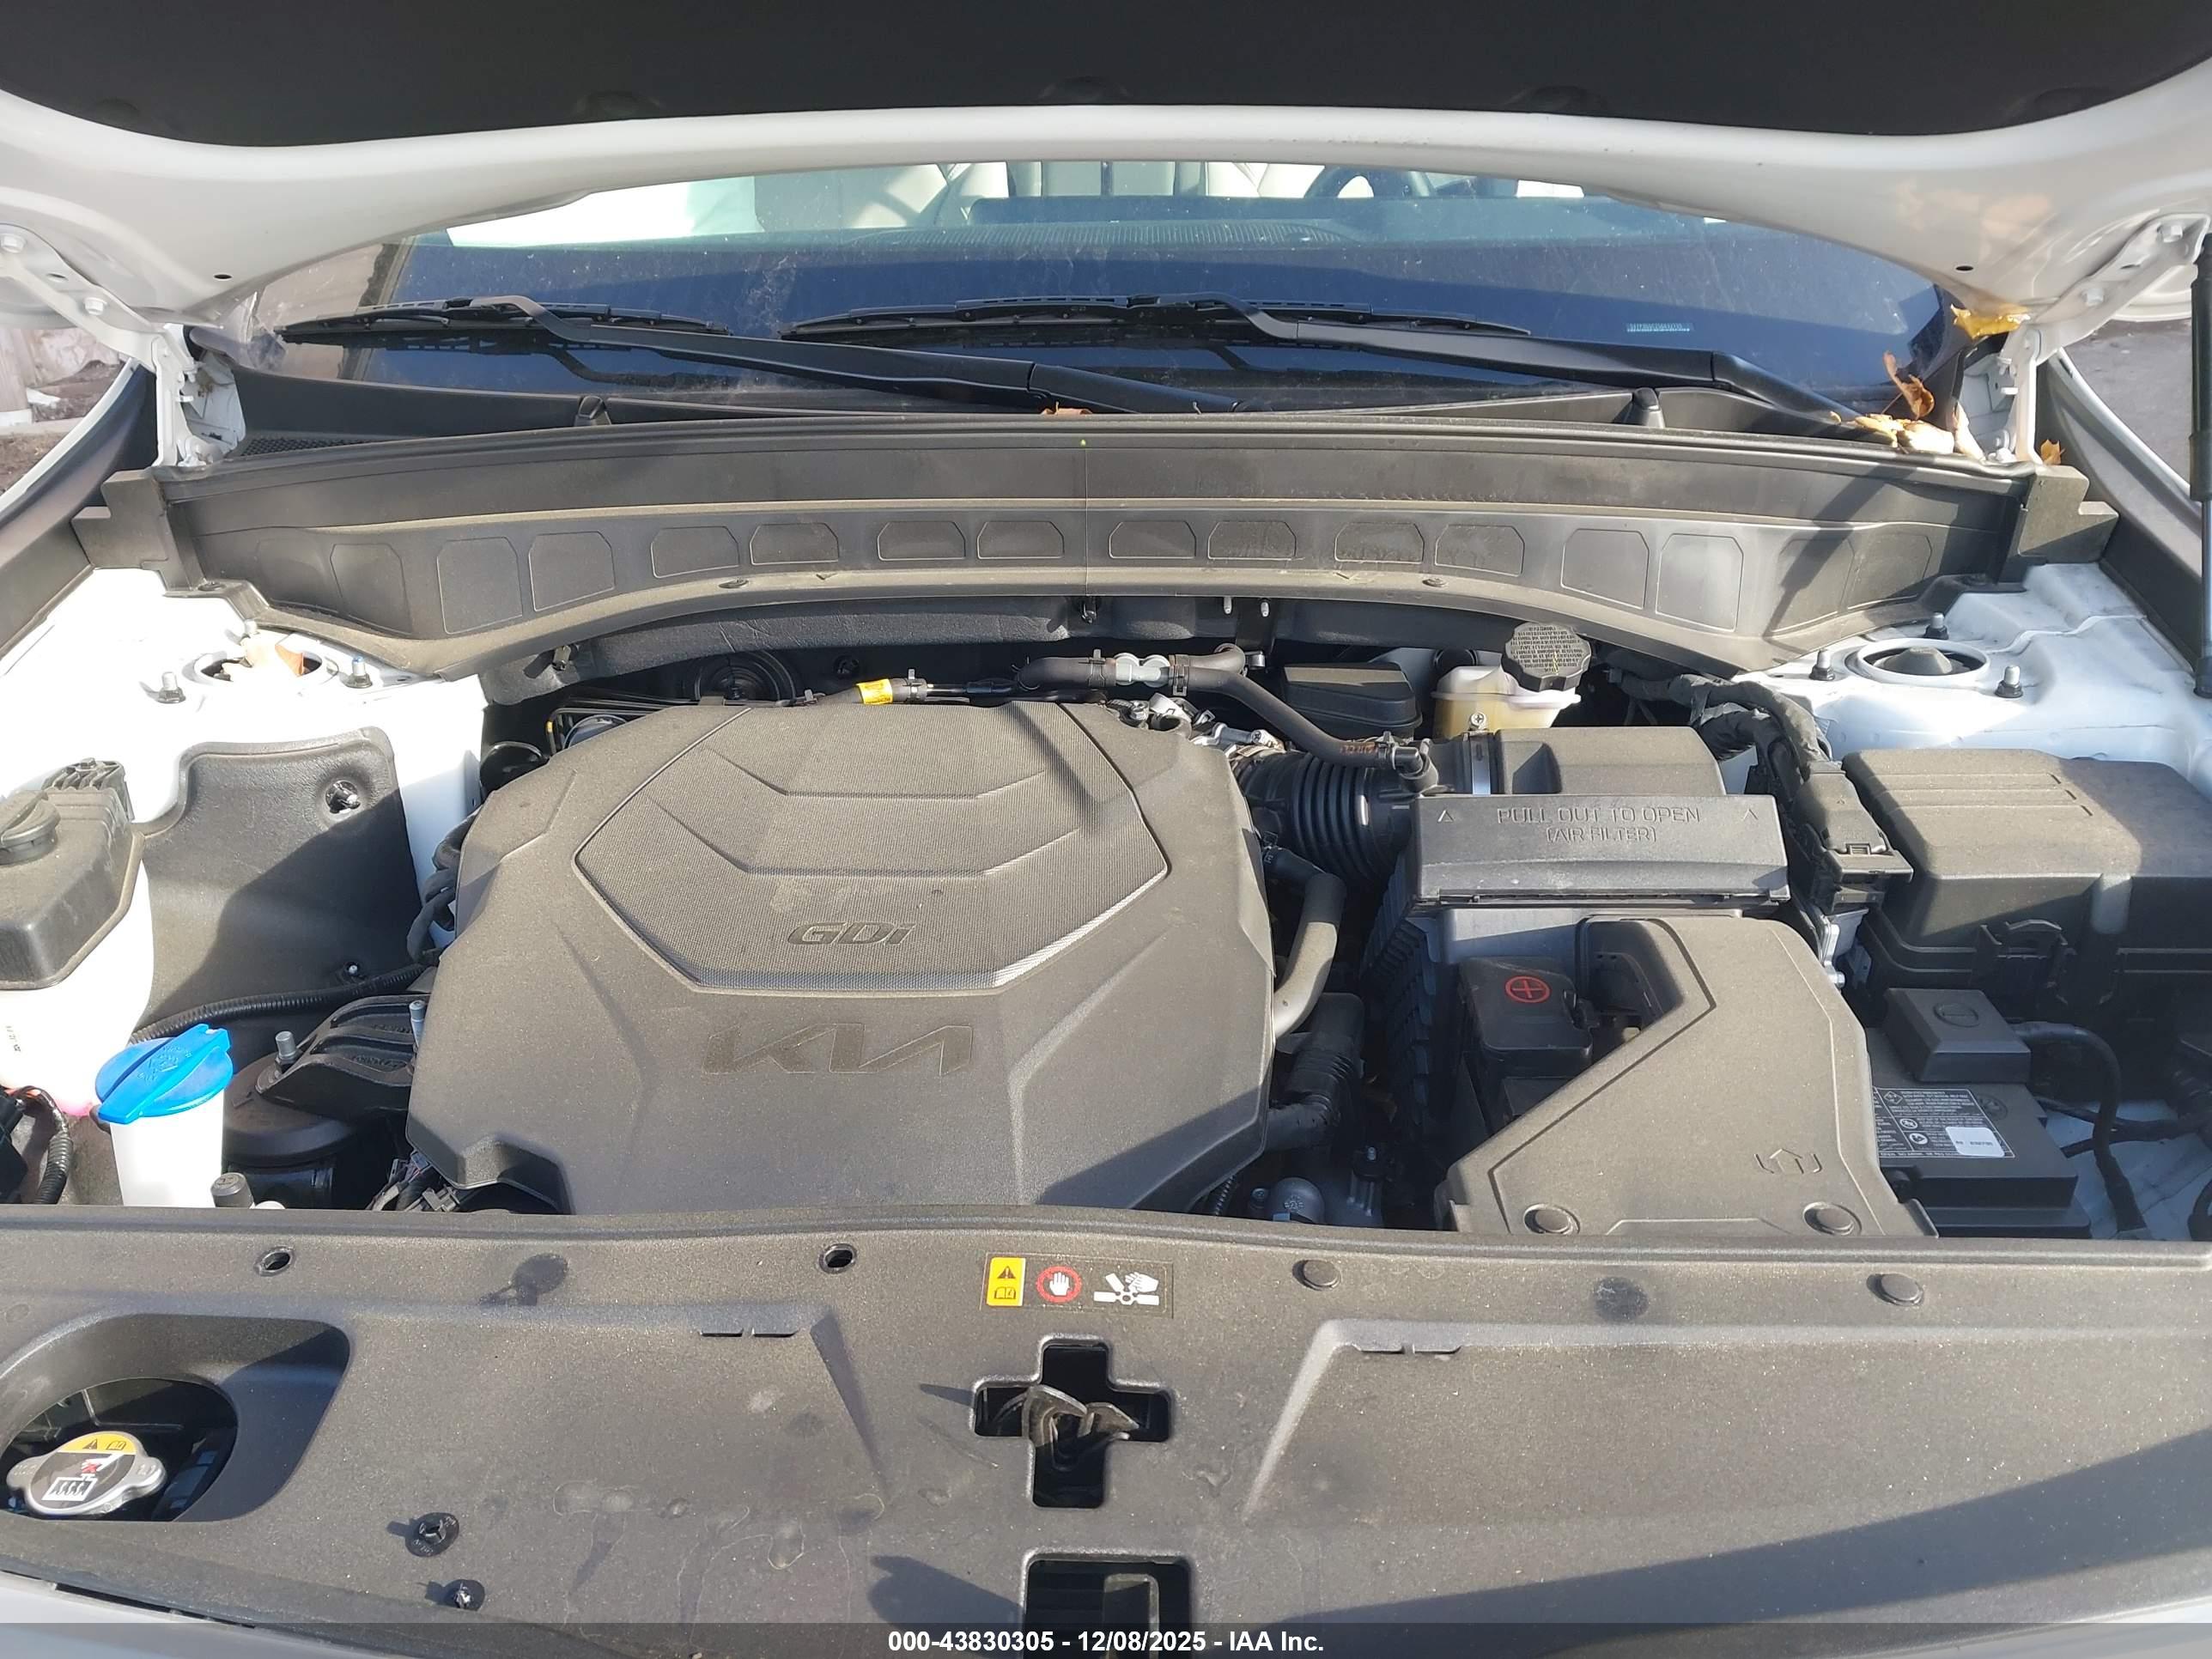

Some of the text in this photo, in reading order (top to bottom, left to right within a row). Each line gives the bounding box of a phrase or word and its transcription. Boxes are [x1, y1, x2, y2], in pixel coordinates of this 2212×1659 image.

[1497, 806, 1700, 824] PULL OUT TO OPEN
[1547, 826, 1657, 842] (AIR FILTER)
[787, 921, 916, 945] GDi
[702, 1023, 974, 1076] KIA
